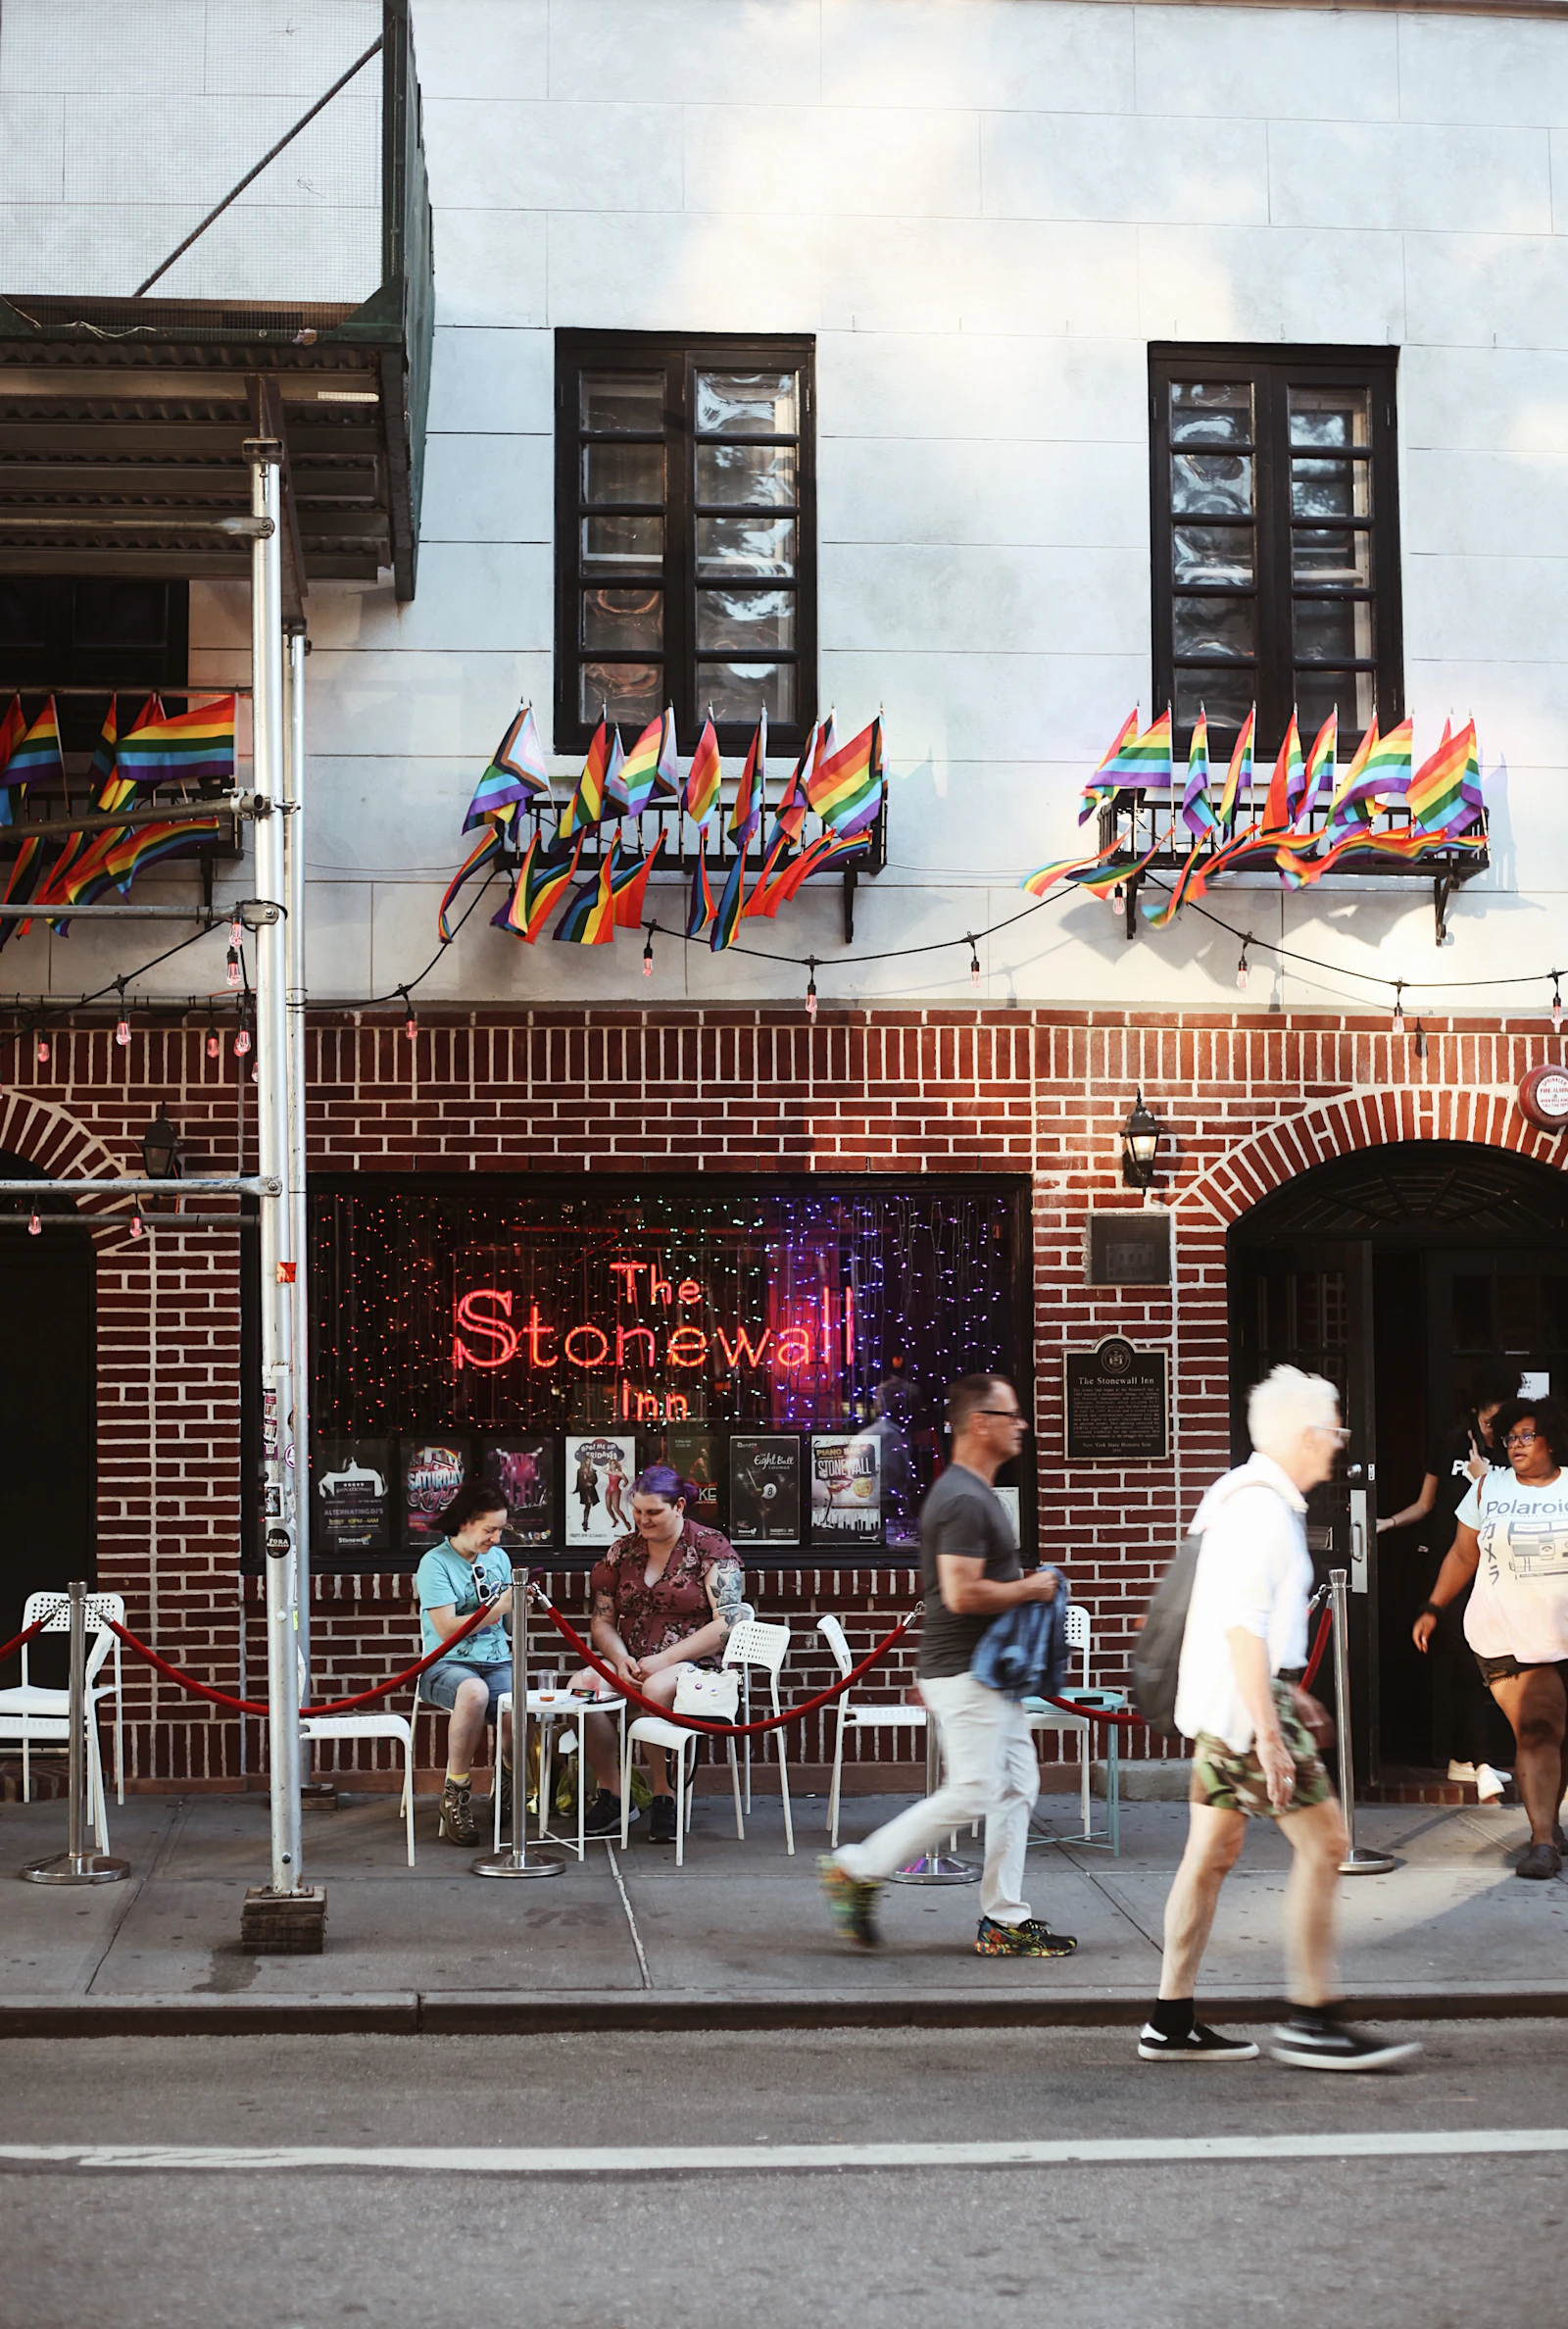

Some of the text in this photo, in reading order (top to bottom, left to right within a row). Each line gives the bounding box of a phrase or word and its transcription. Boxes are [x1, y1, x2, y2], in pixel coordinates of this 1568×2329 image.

[610, 1262, 702, 1305] The
[454, 1286, 856, 1369] Stonewall
[1098, 1376, 1137, 1385] Stonewall
[622, 1378, 689, 1420] Inn
[754, 1452, 795, 1470] Eight Ball
[817, 1458, 872, 1476] STONEWALL
[408, 1468, 465, 1491] SATURDAY
[766, 1487, 773, 1497] 8
[1482, 1520, 1500, 1586] カメラ
